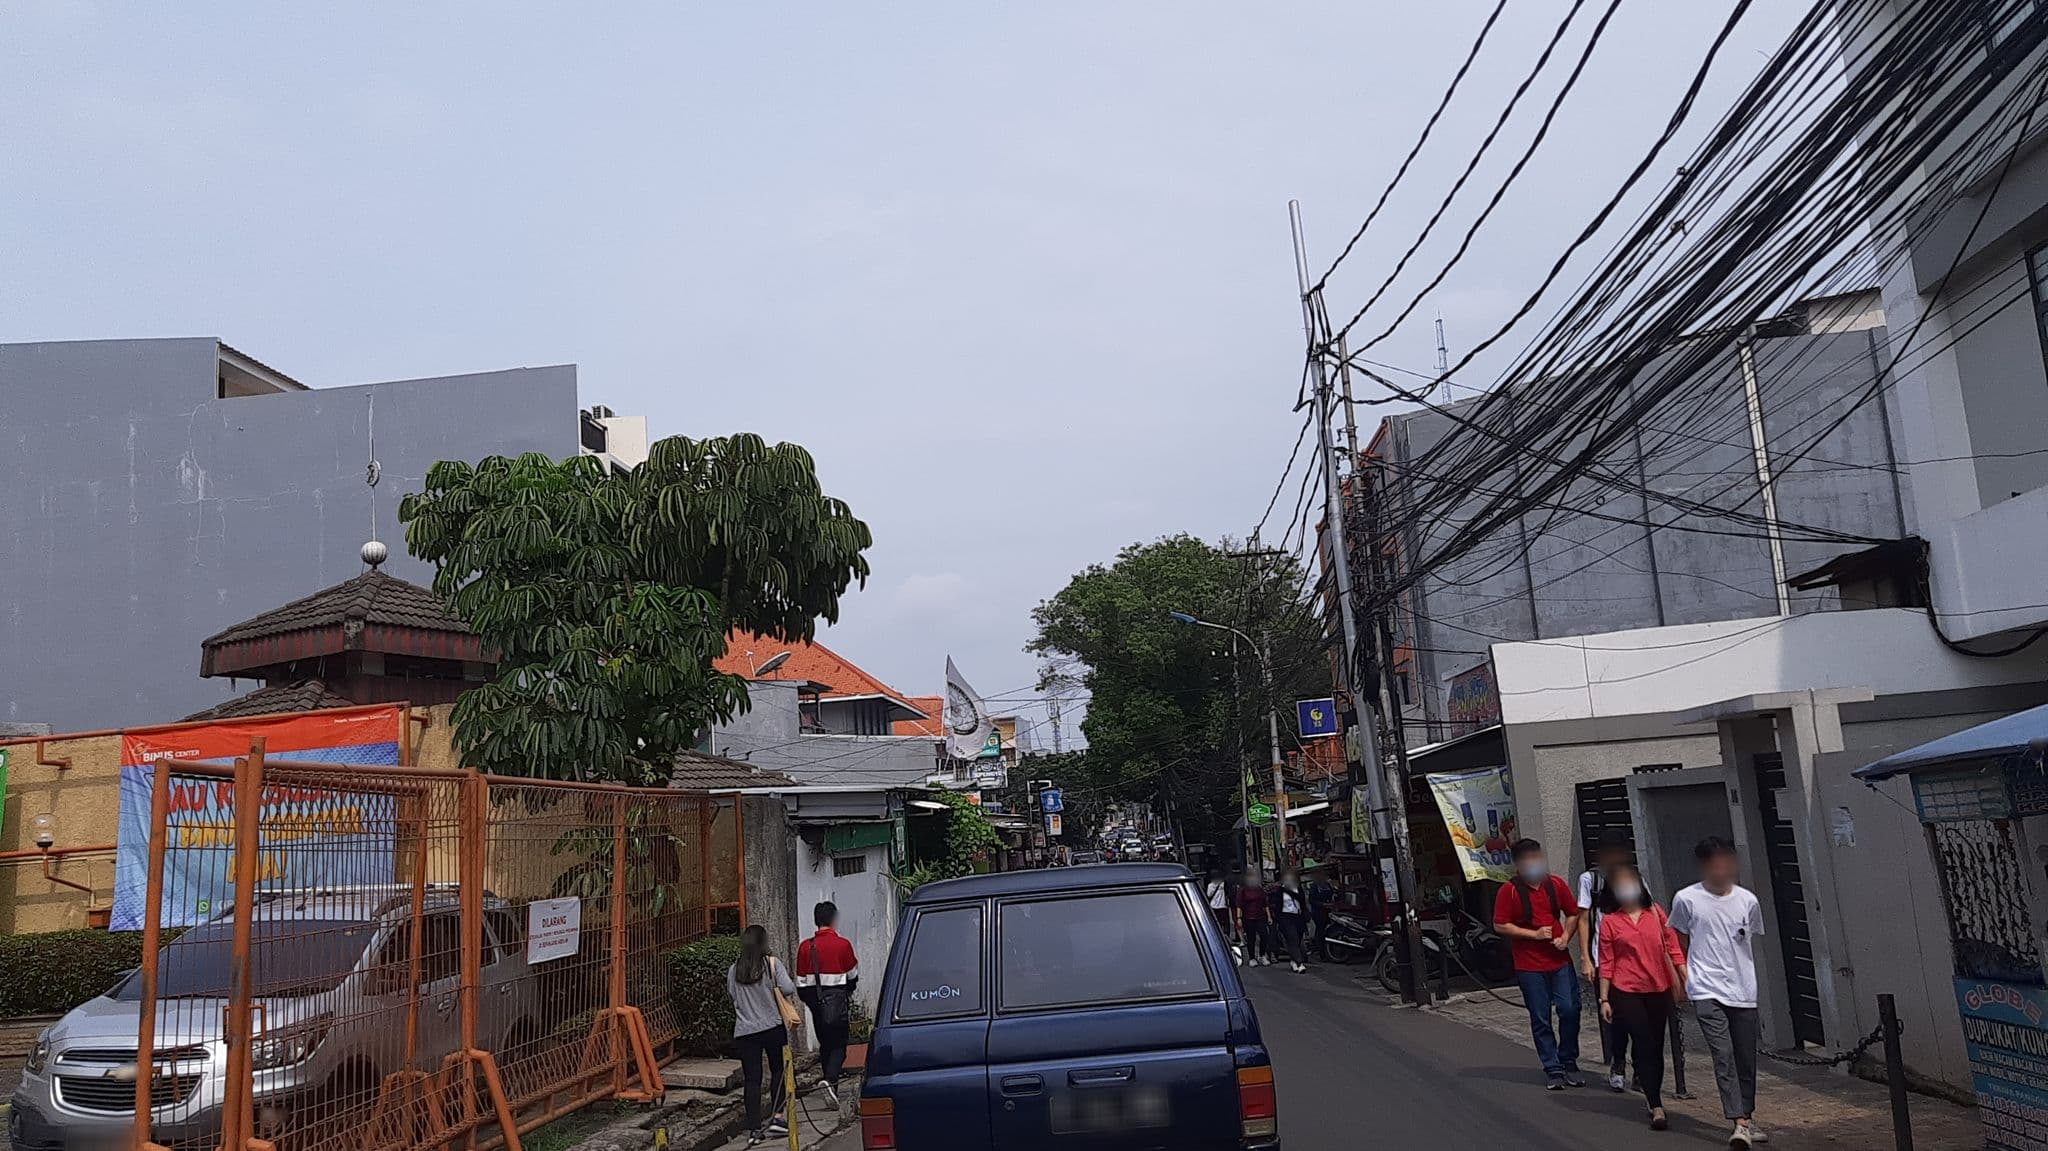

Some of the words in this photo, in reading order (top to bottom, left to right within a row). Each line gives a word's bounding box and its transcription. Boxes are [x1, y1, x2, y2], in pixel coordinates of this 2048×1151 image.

[143, 751, 174, 763] BINUS
[169, 783, 207, 813] AU
[180, 820, 236, 848] BINU
[911, 985, 960, 1000] KUMON
[1964, 984, 2042, 1025] GLOBE
[1964, 1017, 2018, 1051] DUPLIKAT
